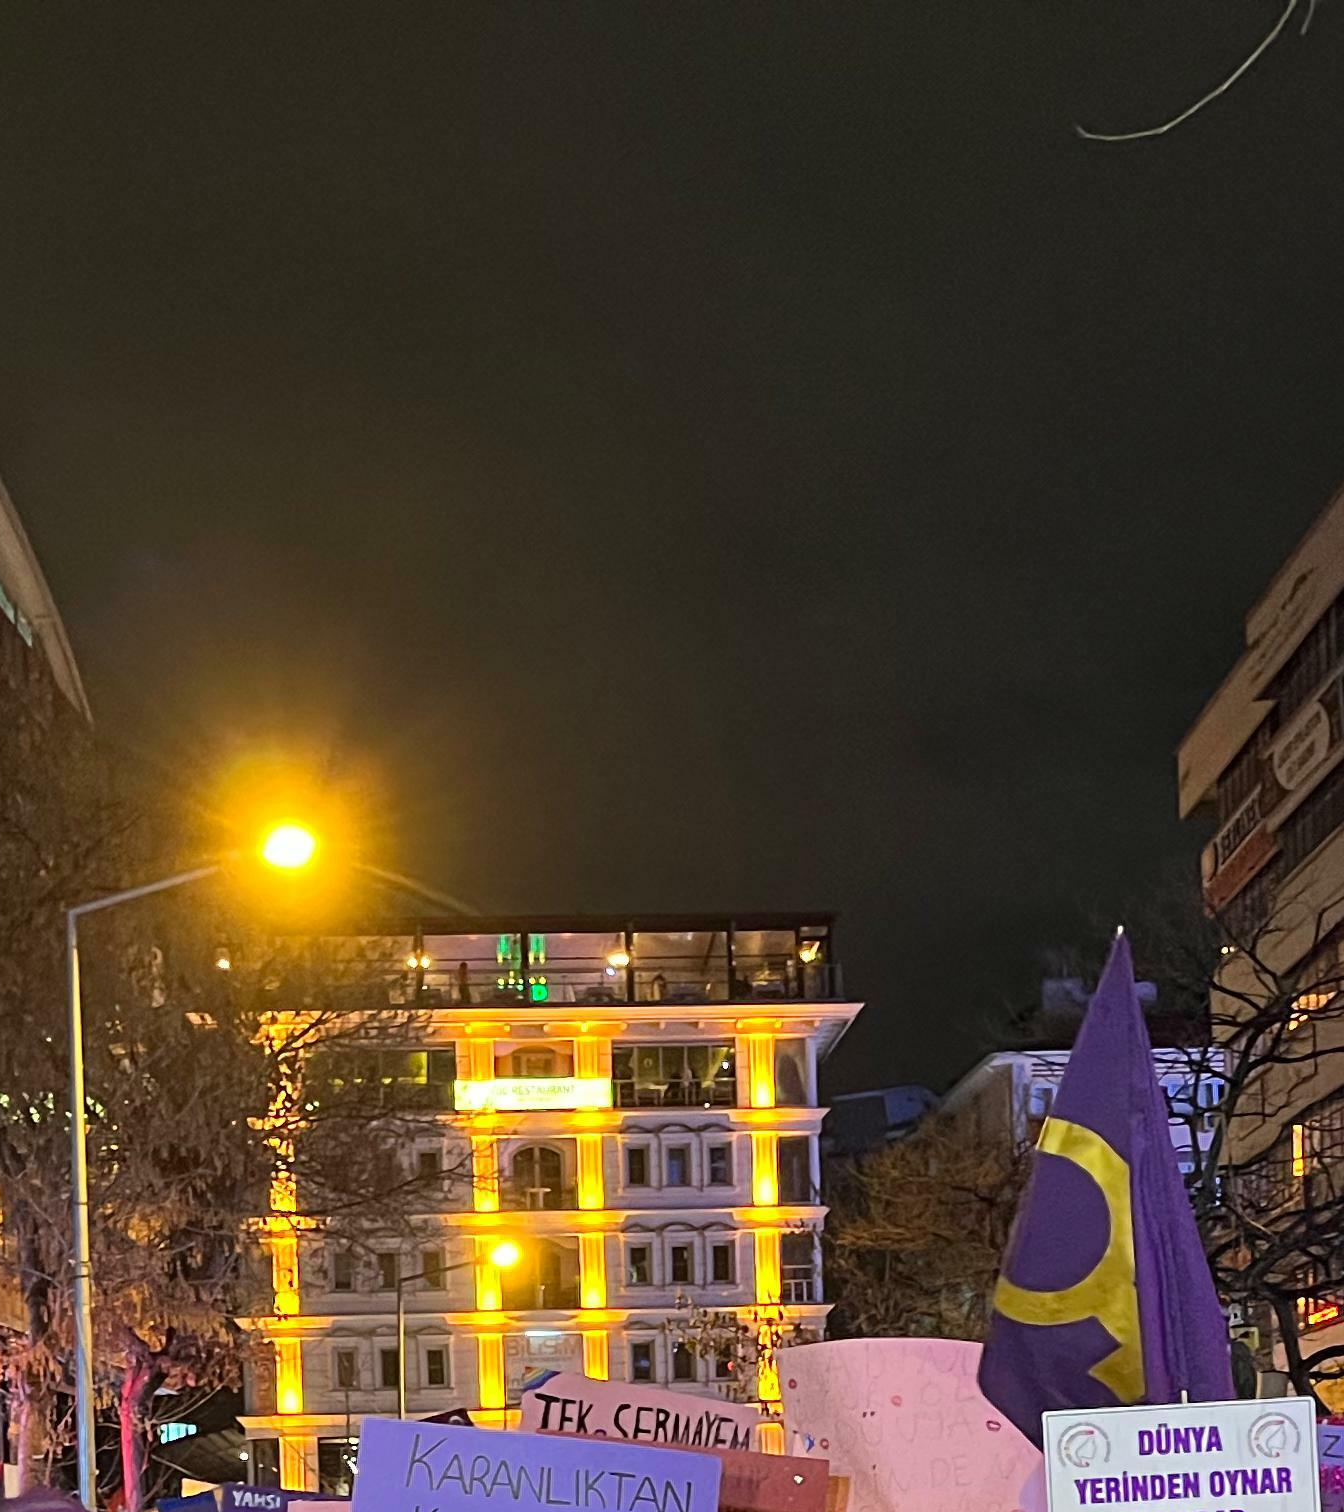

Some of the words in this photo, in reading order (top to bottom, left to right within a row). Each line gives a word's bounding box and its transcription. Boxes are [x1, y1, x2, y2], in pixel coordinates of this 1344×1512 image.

[1137, 1423, 1224, 1456] DÜNYA
[1074, 1471, 1200, 1504] YERİNDEN
[1209, 1467, 1292, 1497] OYNAR
